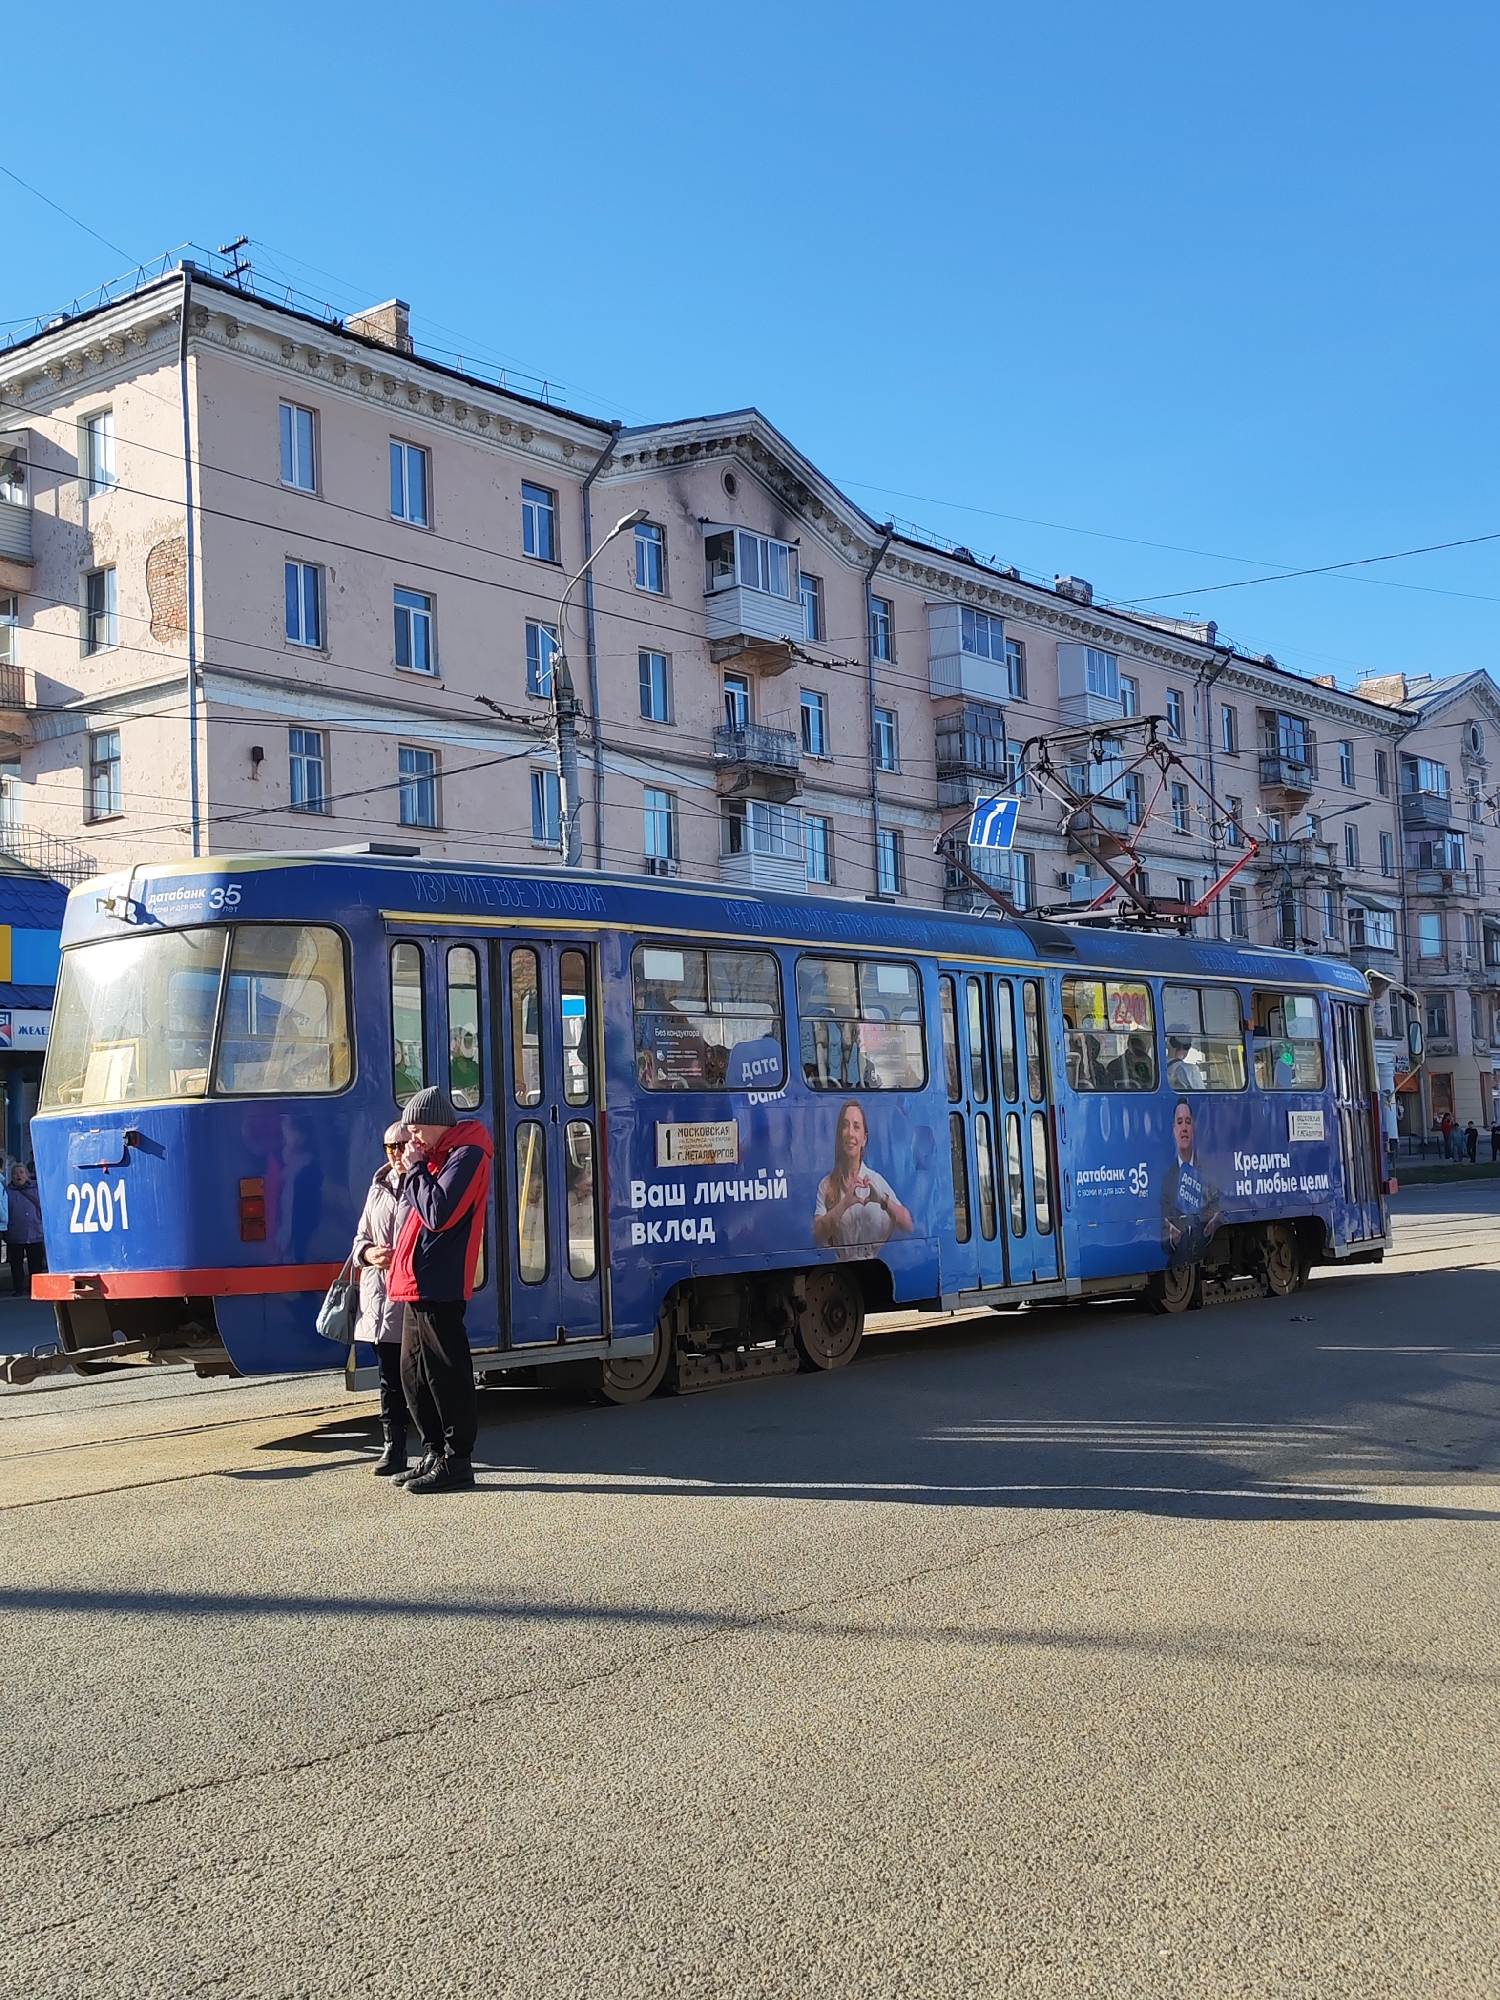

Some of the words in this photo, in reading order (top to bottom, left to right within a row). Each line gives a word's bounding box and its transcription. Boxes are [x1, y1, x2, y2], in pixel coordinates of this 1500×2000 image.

[148, 886, 207, 905] датабанк
[209, 883, 242, 909] 35
[410, 874, 495, 906] ИЗУЧИТЕ
[492, 878, 530, 908] ВСЕ
[527, 882, 607, 912] УСЛОВИЯ
[222, 905, 239, 913] лет
[654, 1027, 667, 1037] Без
[667, 1029, 700, 1039] кондуктора
[741, 1056, 779, 1082] дата
[666, 1130, 671, 1160] 1
[678, 1126, 729, 1138] МОСКОВСКАЯ
[1234, 1151, 1291, 1177] Кредиты
[630, 1180, 686, 1209] Ваш
[693, 1168, 788, 1205] личный
[1076, 1165, 1126, 1186] датабанк
[1128, 1162, 1149, 1194] 35
[1181, 1172, 1202, 1193] дата
[1236, 1179, 1252, 1196] на
[1256, 1172, 1297, 1195] любые
[1300, 1174, 1329, 1194] цели
[66, 1178, 129, 1234] 2201
[1179, 1185, 1200, 1208] банк
[631, 1217, 716, 1245] вклад
